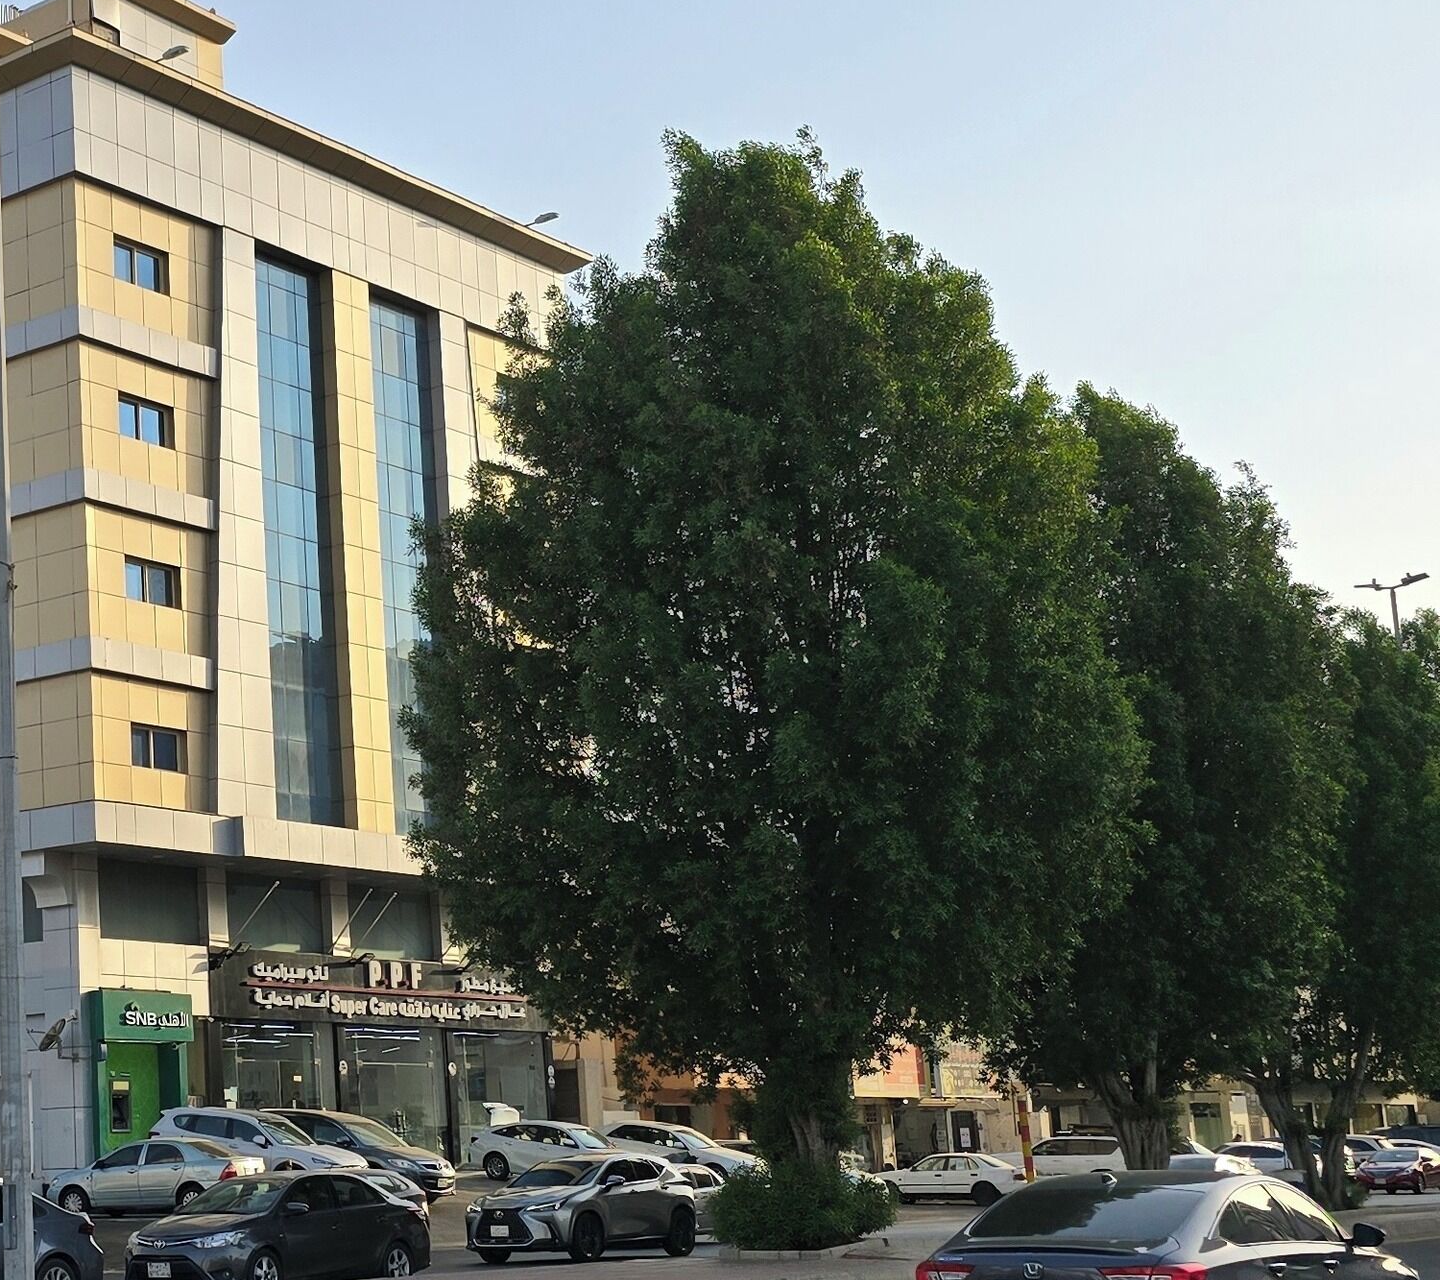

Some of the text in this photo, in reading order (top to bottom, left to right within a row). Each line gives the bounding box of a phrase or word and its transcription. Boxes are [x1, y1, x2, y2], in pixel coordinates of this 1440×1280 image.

[331, 994, 398, 1019] Super Care
[125, 1011, 157, 1026] SNB
